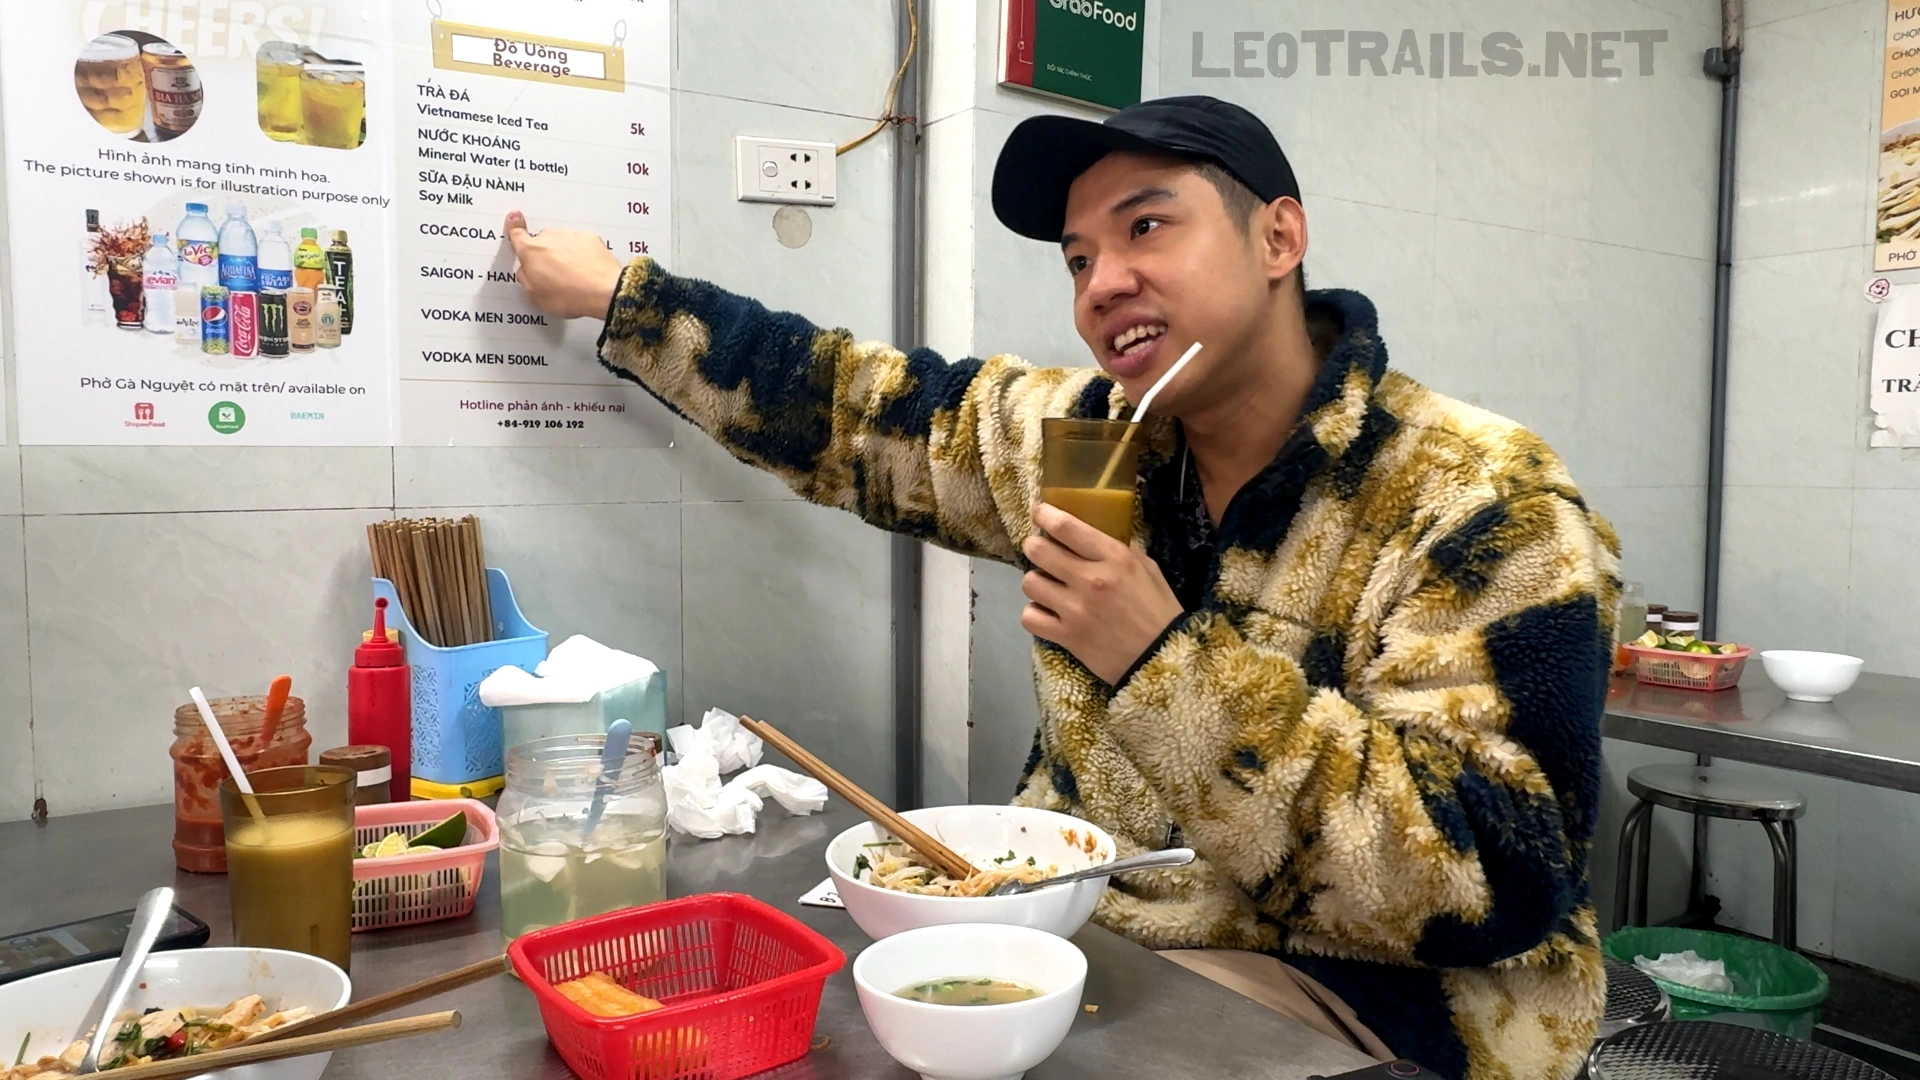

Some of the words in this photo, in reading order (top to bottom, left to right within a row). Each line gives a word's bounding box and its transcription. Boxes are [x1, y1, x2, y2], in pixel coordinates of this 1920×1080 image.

[524, 42, 568, 65] Uống
[493, 52, 571, 78] Beverage
[417, 84, 446, 99] TRÀ
[449, 89, 470, 102] ĐÁ
[417, 103, 494, 124] Vietnamese
[497, 114, 522, 127] Iced
[526, 118, 548, 131] Tea
[630, 123, 645, 136] 5k
[418, 128, 458, 143] NƯỚC
[462, 133, 521, 151] KHOÁNG
[98, 148, 137, 164] Hình
[176, 160, 221, 176] mang
[225, 161, 255, 177] tính
[260, 166, 297, 181] minh
[418, 147, 466, 162] Mineral
[470, 152, 510, 168] Water
[514, 158, 526, 171] (1
[530, 160, 569, 176] bottle)
[627, 163, 649, 176] 10k
[24, 159, 57, 174] The
[60, 163, 120, 182] picture
[124, 171, 176, 187] shown
[181, 174, 192, 188] is
[196, 175, 216, 191] for
[221, 179, 298, 199] illustration
[302, 188, 358, 206] purpose
[361, 194, 390, 209] only
[419, 169, 449, 185] SỮA
[451, 173, 482, 190] ĐẬU
[486, 177, 525, 193] NÀNH
[419, 189, 443, 205] Soy
[447, 192, 474, 206] Milk
[627, 201, 649, 215] 10k
[419, 223, 496, 241] COCACOLA
[628, 241, 649, 254] 15k
[146, 274, 177, 285] evian
[420, 266, 474, 280] SAIGON
[487, 271, 521, 283] HAN
[421, 308, 471, 322] VODKA
[475, 312, 503, 324] MEN
[507, 313, 548, 326] 300ML
[422, 351, 472, 364] VODKA
[475, 353, 504, 365] MEN
[507, 354, 548, 366] 500ML
[80, 376, 112, 390] Phở
[115, 378, 136, 390] Gà
[140, 378, 195, 394] Nguyệt
[198, 379, 216, 392] có
[252, 381, 285, 394] trên/
[288, 383, 346, 395] available
[349, 386, 366, 396] on
[460, 399, 504, 411] Hotline
[507, 399, 538, 413] phản
[541, 400, 564, 412] ánh
[574, 400, 605, 413] khiếu
[608, 403, 626, 416] nại
[497, 419, 541, 430] +84-919
[544, 420, 563, 430] 106
[566, 420, 584, 430] 192
